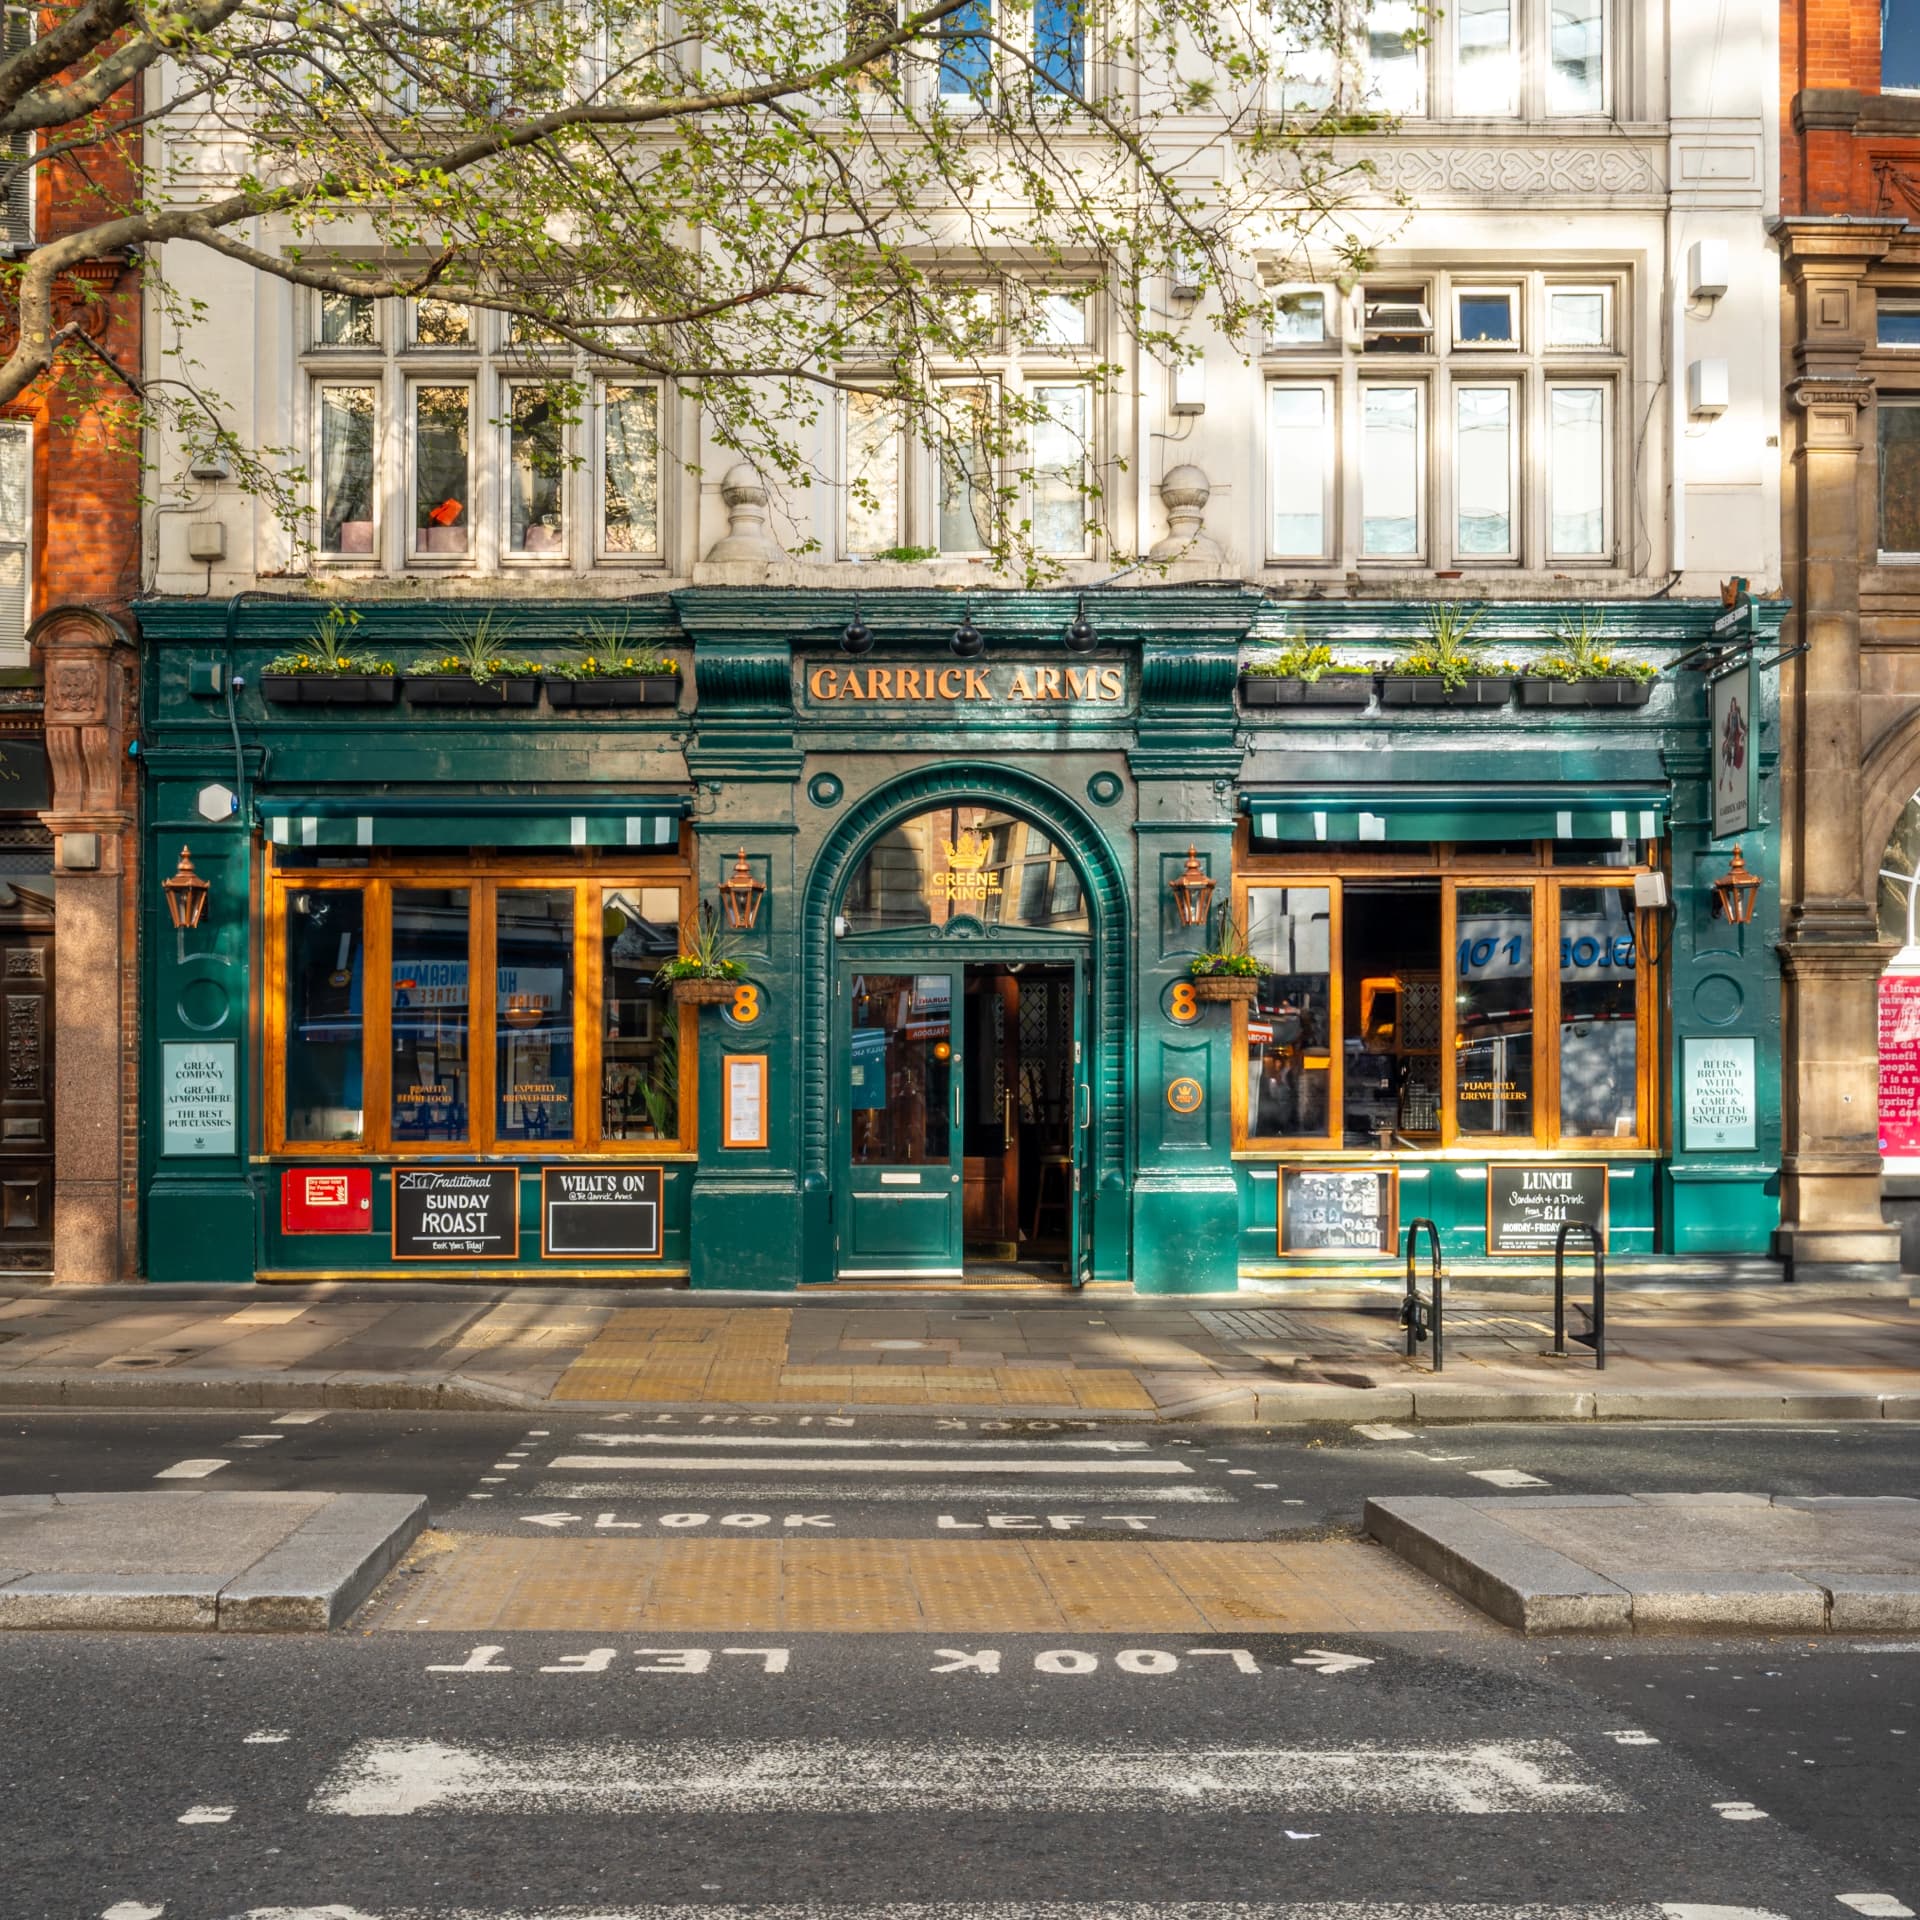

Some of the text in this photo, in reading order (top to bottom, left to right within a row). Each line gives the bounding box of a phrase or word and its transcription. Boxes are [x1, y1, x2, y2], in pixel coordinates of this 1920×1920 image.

[810, 668, 1123, 701] GARRICK ARMS
[932, 872, 999, 886] GREENE
[945, 886, 987, 901] KING
[732, 984, 759, 1022] 8
[1171, 983, 1197, 1020] 8
[183, 1061, 216, 1070] GREAT
[1703, 1060, 1736, 1069] BEERS
[175, 1071, 225, 1079] COMPANY
[1697, 1070, 1742, 1078] BREWED
[1705, 1079, 1734, 1087] WITH
[183, 1085, 216, 1094] GREAT
[1696, 1088, 1744, 1097] PASSION,
[1879, 1085, 1915, 1097] failing
[168, 1094, 232, 1103] ATMOSPHERE
[541, 1094, 568, 1103] BEERS
[1701, 1097, 1738, 1106] CARE &
[1879, 1097, 1914, 1109] spring
[177, 1110, 224, 1118] THE BEST
[1692, 1106, 1746, 1115] EXPERTISE
[168, 1119, 232, 1128] PUB CLASSICS
[1692, 1115, 1748, 1124] SINCE 1799
[429, 1173, 491, 1189] Traditional
[560, 1175, 645, 1192] WHAT'S ON
[1522, 1172, 1573, 1190] LUNCH
[427, 1194, 490, 1209] SUNDAY
[422, 1212, 488, 1233] ROAST
[934, 1420, 1097, 1431] LOOK
[595, 1513, 1157, 1529] LOOK LEFT
[425, 1645, 1263, 1674] LOOK LEFT
